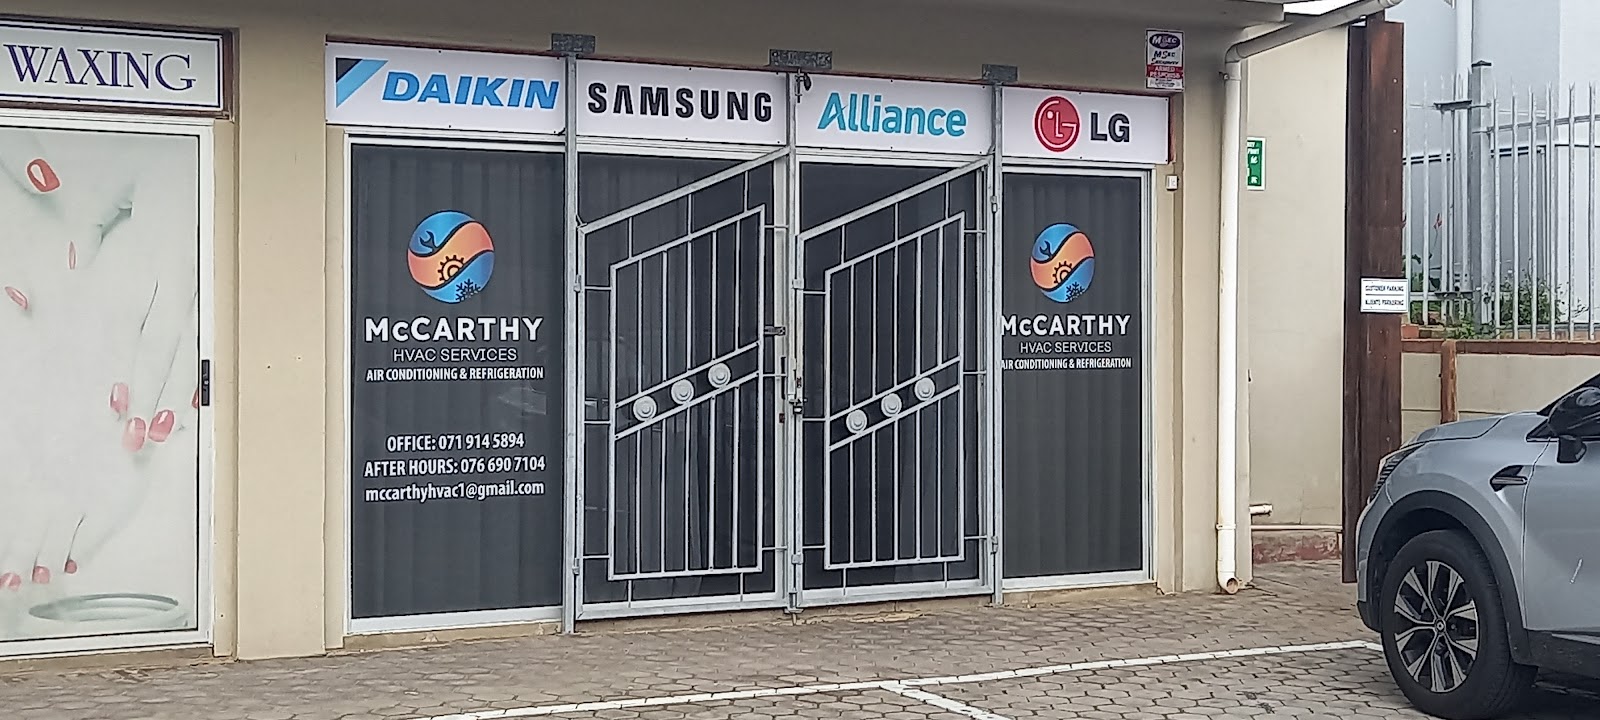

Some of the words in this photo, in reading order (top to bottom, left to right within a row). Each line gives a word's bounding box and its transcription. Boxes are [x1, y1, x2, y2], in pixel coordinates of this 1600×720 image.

[3, 44, 196, 91] WAXING
[382, 71, 559, 109] DAIKIN
[587, 84, 773, 122] SAMSUNG
[817, 92, 968, 137] Alliance
[1090, 112, 1130, 143] LG
[365, 316, 544, 342] McCARTHY
[1001, 315, 1131, 336] McCARTHY
[393, 348, 437, 363] HVAC
[440, 348, 518, 362] SERVICES
[1020, 341, 1052, 354] HVAC
[1054, 341, 1112, 353] SERVICES
[366, 368, 385, 382] AIR
[386, 367, 458, 381] CONDITIONING
[459, 367, 468, 380] &
[469, 366, 544, 380] REFRIGERATION
[1001, 359, 1014, 370] AIR
[1014, 358, 1068, 370] CONDITIONING
[1069, 358, 1075, 368] &
[1076, 357, 1132, 369] REFRIGERATION
[386, 435, 437, 452] OFFICE:
[438, 434, 463, 450] 071
[465, 433, 491, 449] 914
[492, 432, 525, 448] 5894
[364, 461, 406, 477] AFTER
[409, 458, 459, 475] HOURS:
[460, 457, 486, 473] 076
[487, 456, 512, 472] 690
[514, 455, 546, 471] 7104
[365, 480, 545, 503] mccarthyhvac1@gmail.com
